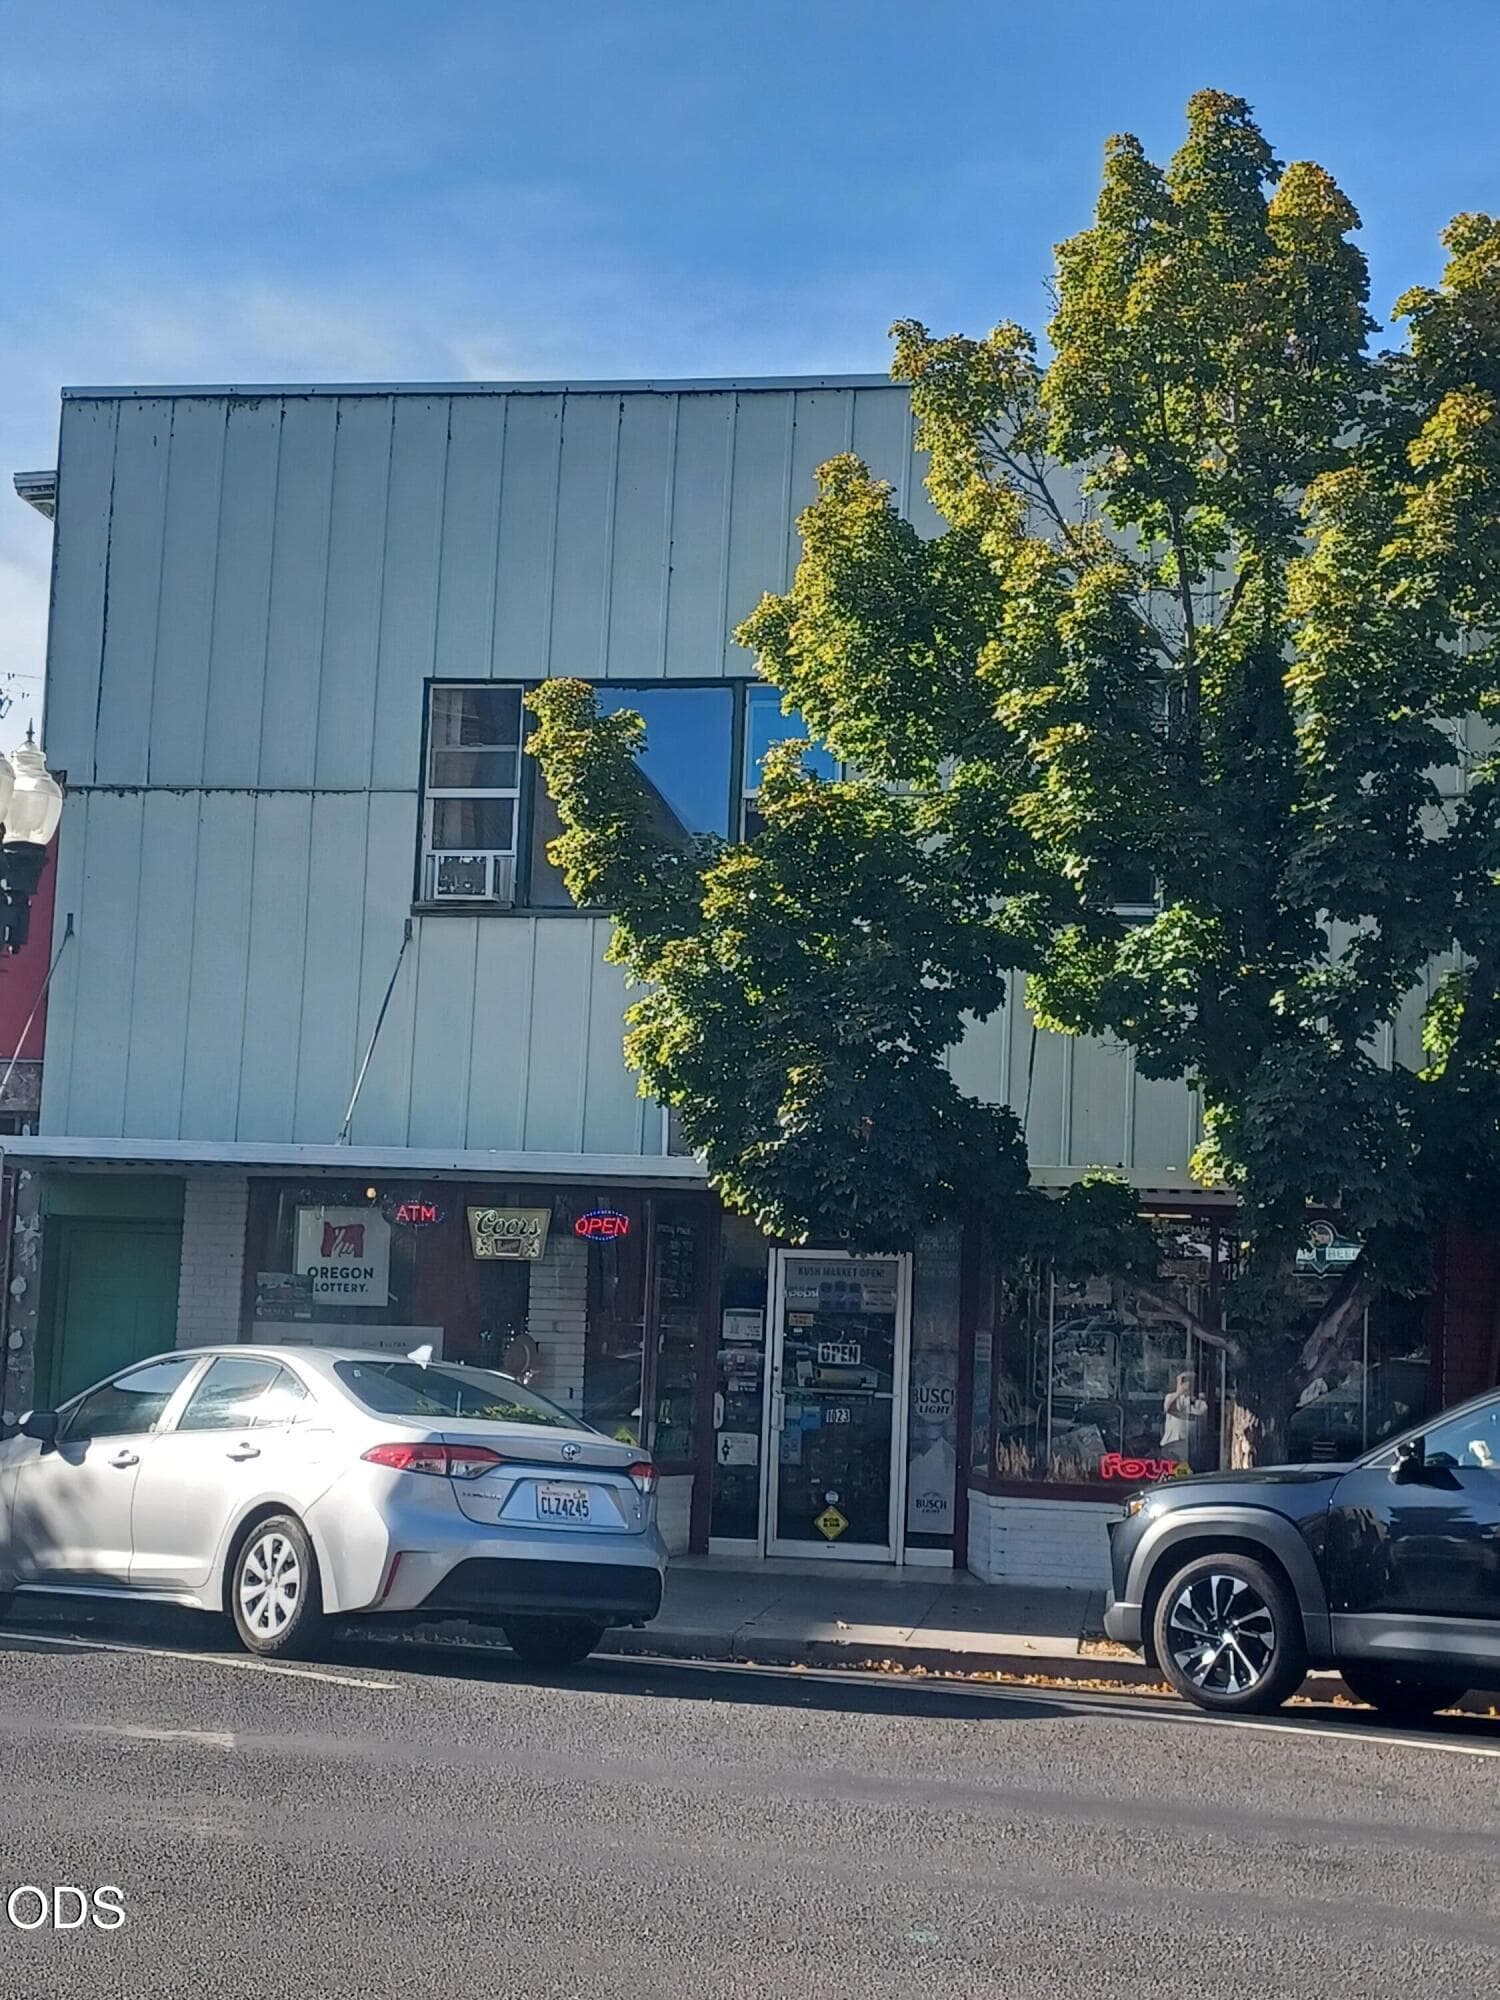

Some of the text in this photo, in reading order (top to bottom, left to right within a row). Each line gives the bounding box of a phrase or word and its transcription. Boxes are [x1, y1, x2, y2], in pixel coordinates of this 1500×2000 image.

[395, 1205, 436, 1222] ATM
[475, 1209, 541, 1236] Coors
[574, 1215, 630, 1236] OPEN
[307, 1266, 374, 1279] OREGON
[821, 1344, 858, 1363] OPEN
[827, 1409, 850, 1422] 1023
[919, 1405, 950, 1415] LIGHT
[541, 1496, 589, 1517] CLZ4245
[915, 1498, 947, 1510] BUSCH
